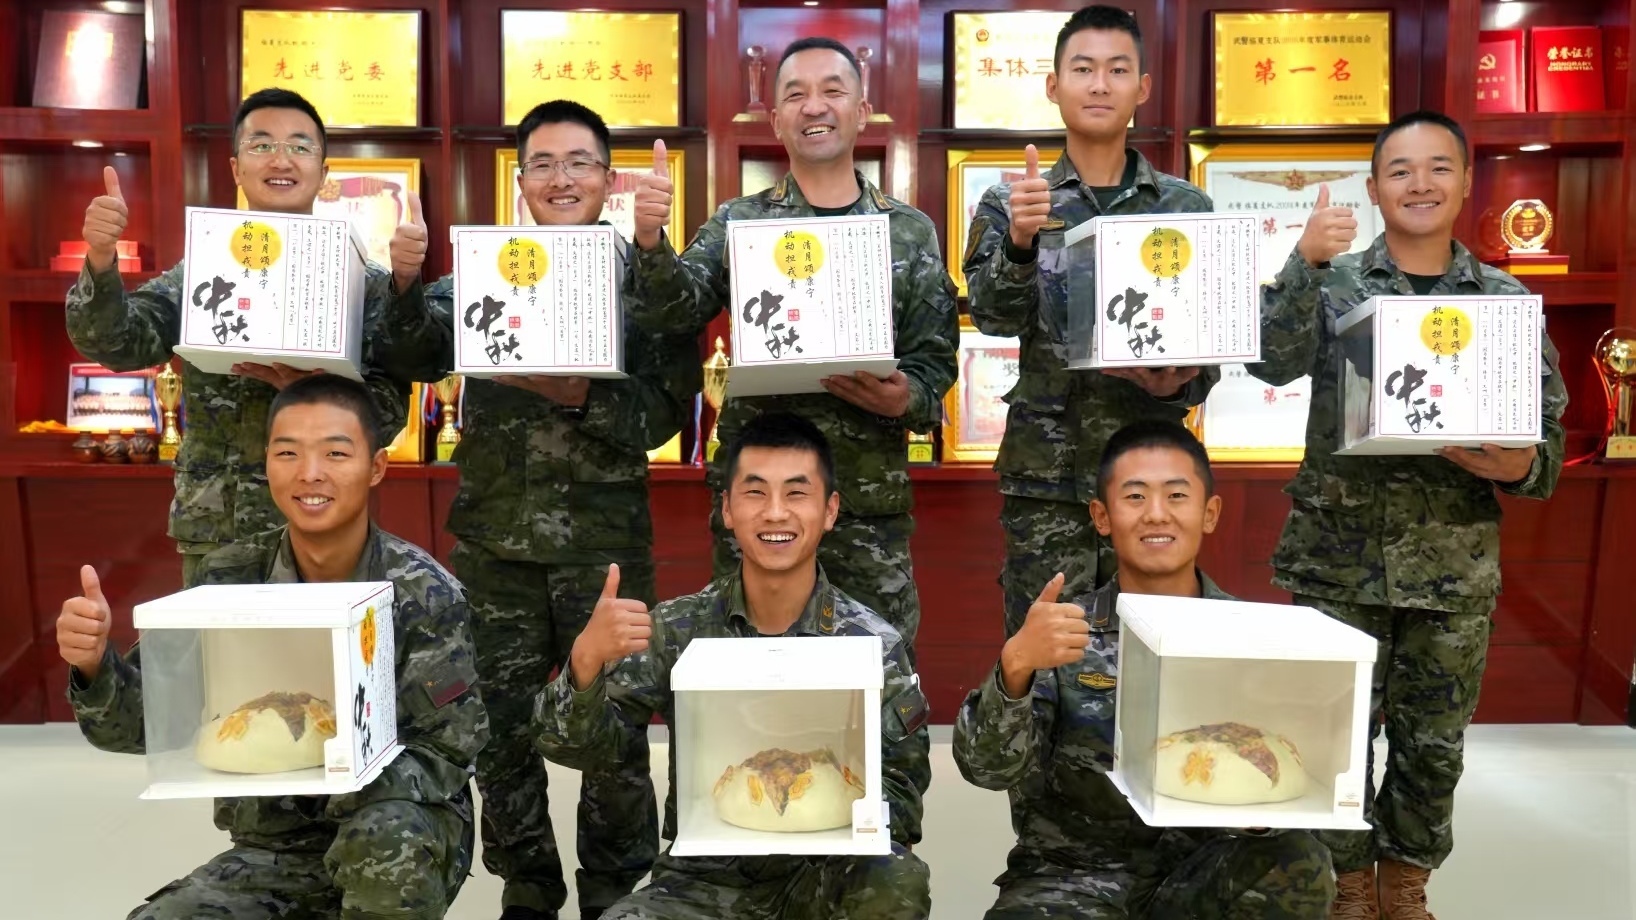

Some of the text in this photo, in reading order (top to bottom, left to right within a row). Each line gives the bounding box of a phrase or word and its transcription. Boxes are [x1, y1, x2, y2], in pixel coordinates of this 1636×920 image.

[273, 57, 385, 81] 先进党委
[531, 58, 654, 82] 先进党支部
[1254, 57, 1351, 85] 第一名
[1547, 46, 1594, 60] 荣誉证书
[259, 231, 270, 290] 清月颂康宁
[527, 247, 538, 307] 清月颂康宁
[802, 239, 815, 299] 清月颂康宁
[1169, 236, 1181, 298] 清月颂康宁
[192, 275, 250, 345] 中秋
[463, 294, 523, 365] 中秋
[742, 289, 803, 359] 中秋
[1106, 287, 1166, 358] 中秋
[1449, 316, 1461, 375] 清月颂康宁
[1384, 363, 1444, 434] 中秋
